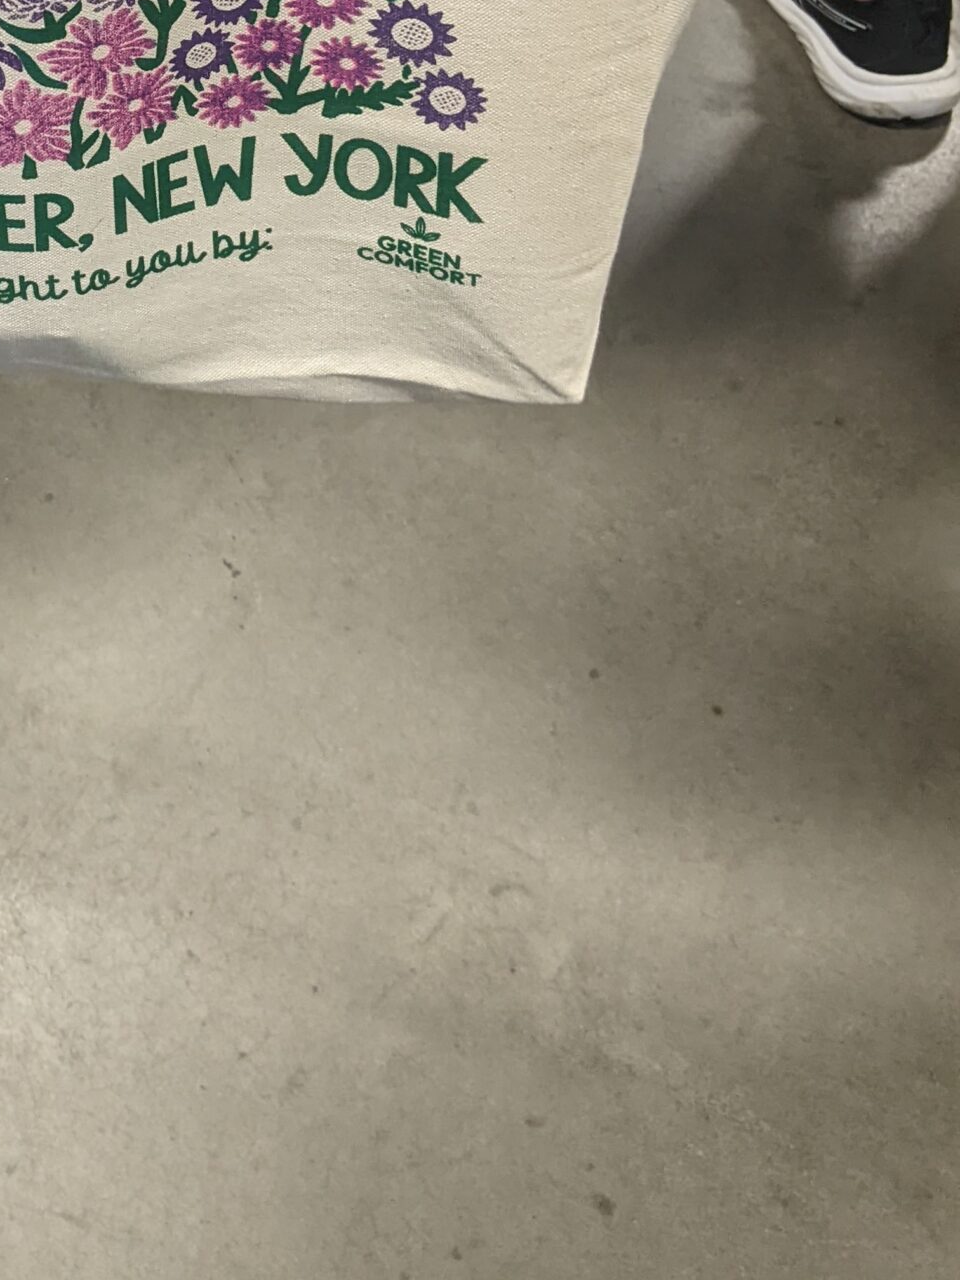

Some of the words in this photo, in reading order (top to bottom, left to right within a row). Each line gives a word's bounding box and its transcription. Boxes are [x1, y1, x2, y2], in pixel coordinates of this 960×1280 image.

[112, 135, 257, 235] NEW
[280, 132, 489, 224] YORK
[71, 265, 120, 295] to
[125, 241, 208, 289] you
[212, 226, 273, 262] by:
[356, 246, 483, 287] COMFORT
[377, 235, 462, 270] GREEN
